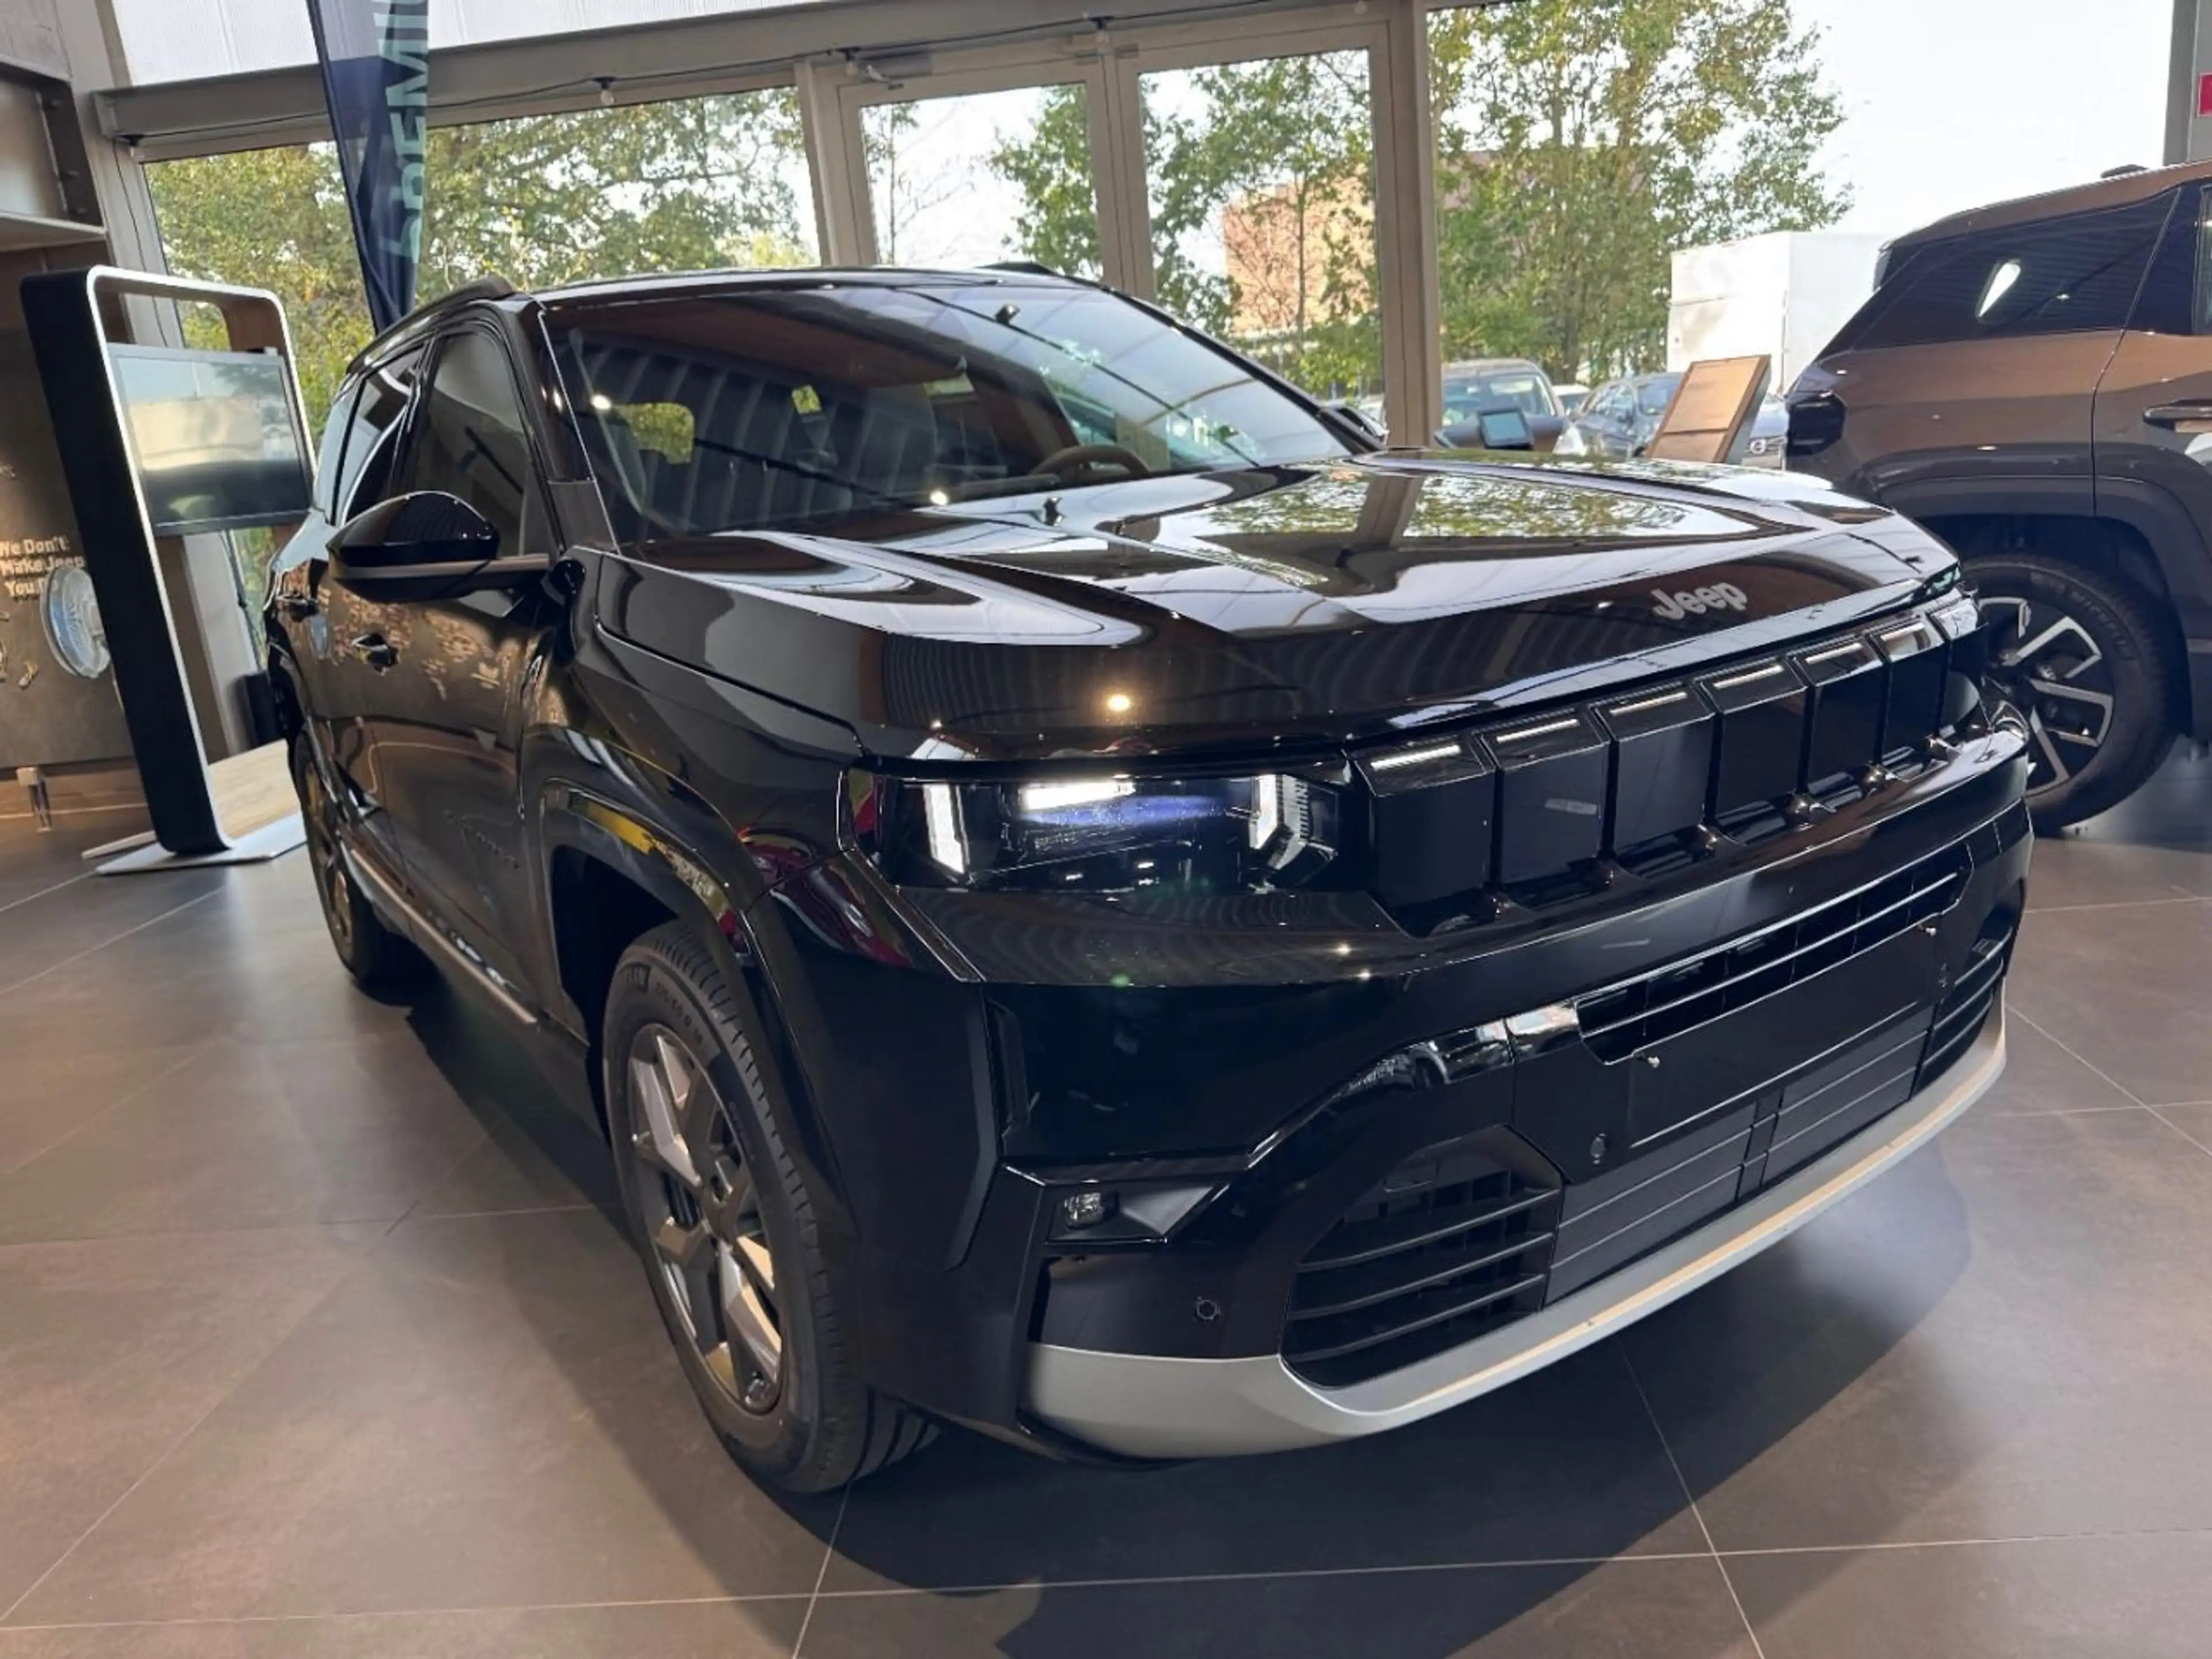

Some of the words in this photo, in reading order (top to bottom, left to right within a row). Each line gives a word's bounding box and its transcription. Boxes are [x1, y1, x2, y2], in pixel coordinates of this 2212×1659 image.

[23, 536, 69, 554] Don't
[0, 558, 43, 575] Make
[5, 579, 35, 597] You
[1650, 582, 1748, 620] Jeep
